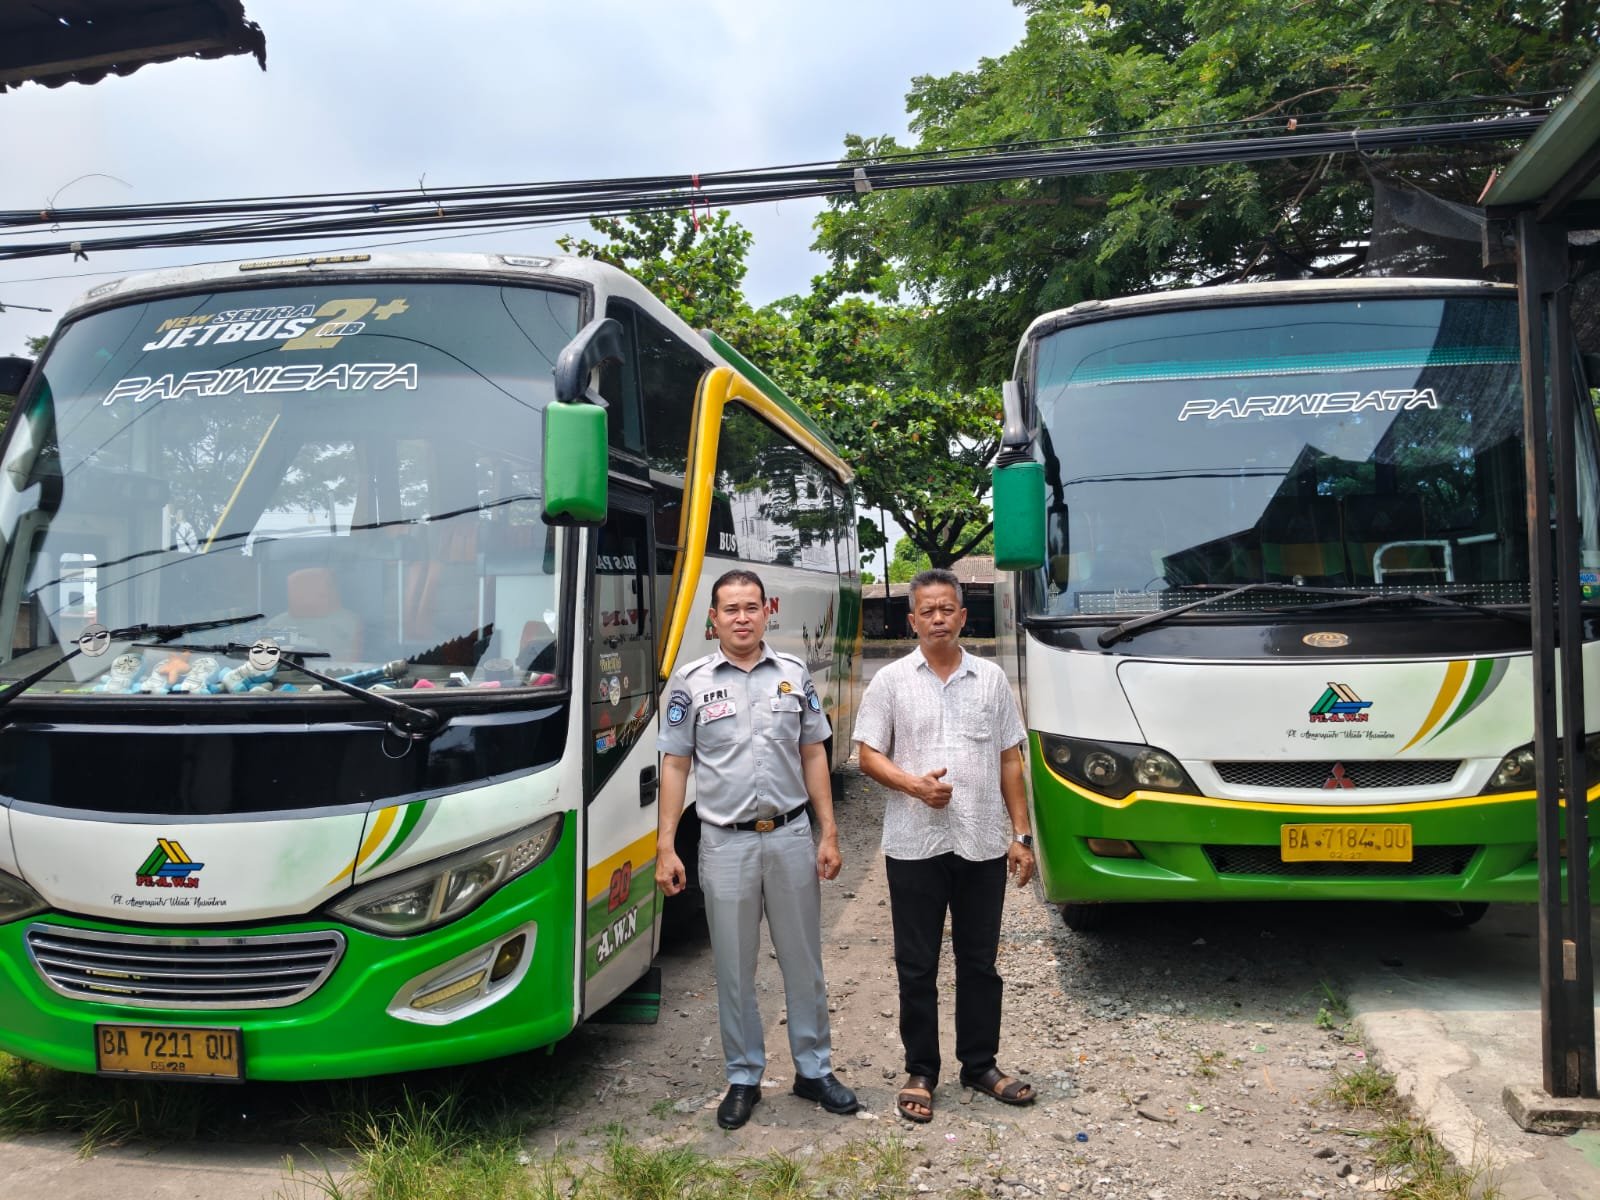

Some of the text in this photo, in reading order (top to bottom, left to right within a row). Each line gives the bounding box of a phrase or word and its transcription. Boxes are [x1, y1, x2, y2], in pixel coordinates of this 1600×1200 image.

[156, 304, 316, 333] NEW SETRA
[143, 318, 316, 351] JETBUS
[102, 363, 418, 406] PARIWISATA
[1178, 388, 1439, 421] PARIWISATA
[719, 532, 737, 552] BUS
[703, 688, 728, 703] EFRI
[1288, 828, 1309, 849] BA
[1323, 827, 1370, 849] 7184
[608, 861, 632, 914] 20
[102, 1030, 233, 1060] BA 7211 QU
